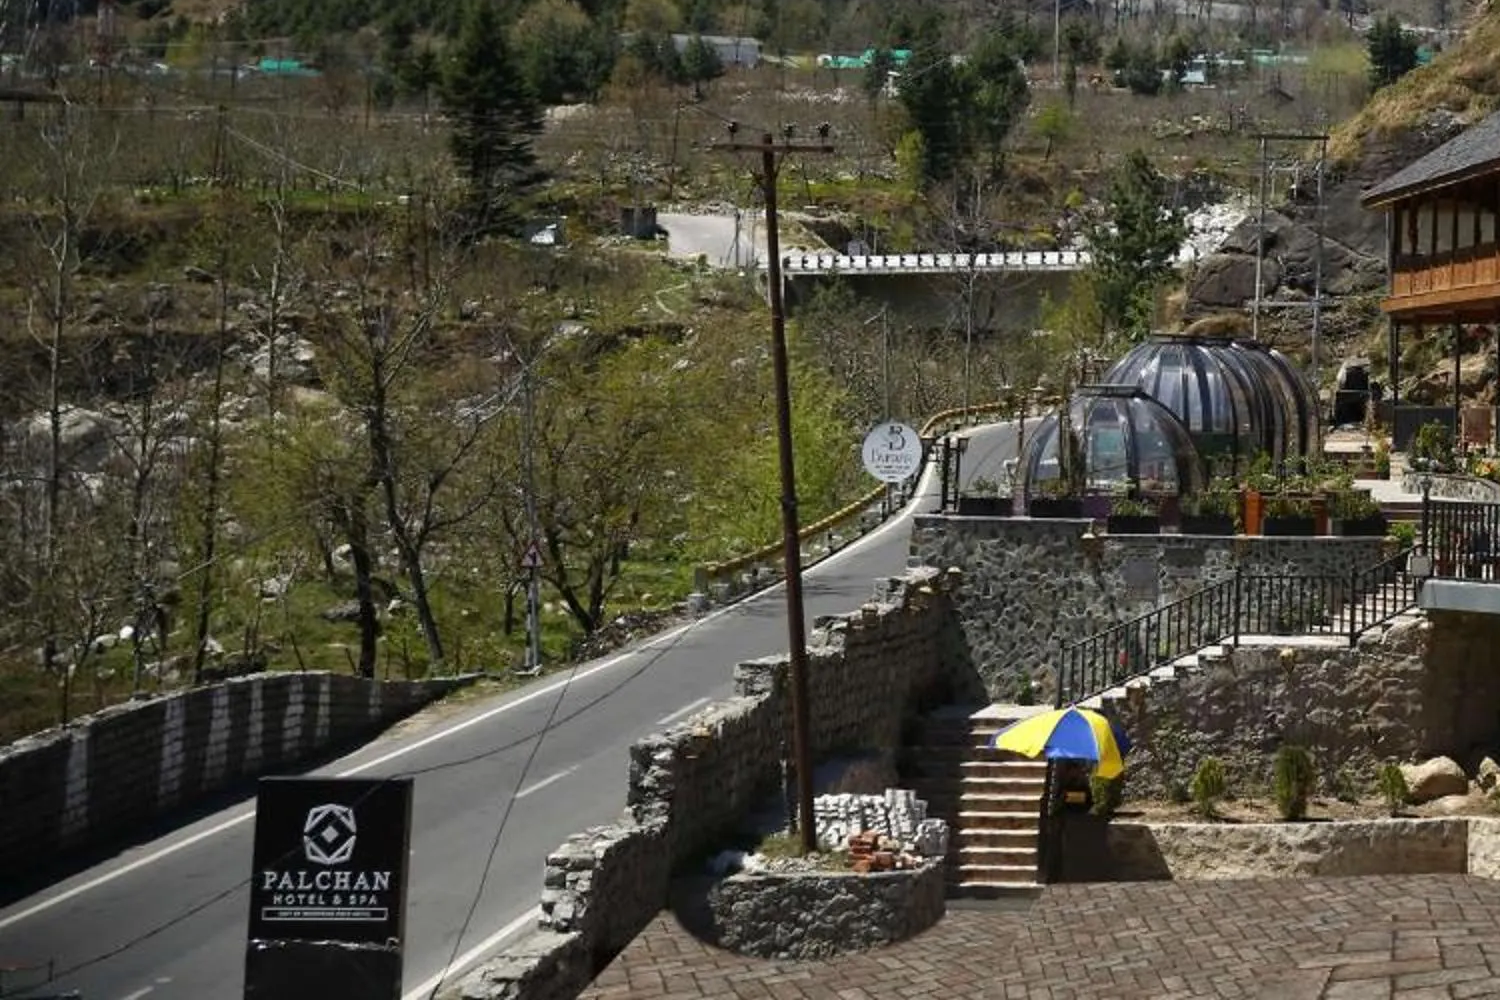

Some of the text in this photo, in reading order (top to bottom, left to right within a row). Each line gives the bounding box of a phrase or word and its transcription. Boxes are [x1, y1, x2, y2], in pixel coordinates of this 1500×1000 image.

[263, 870, 391, 890] PALCHAN
[273, 893, 378, 905] HOTEL & SPA
